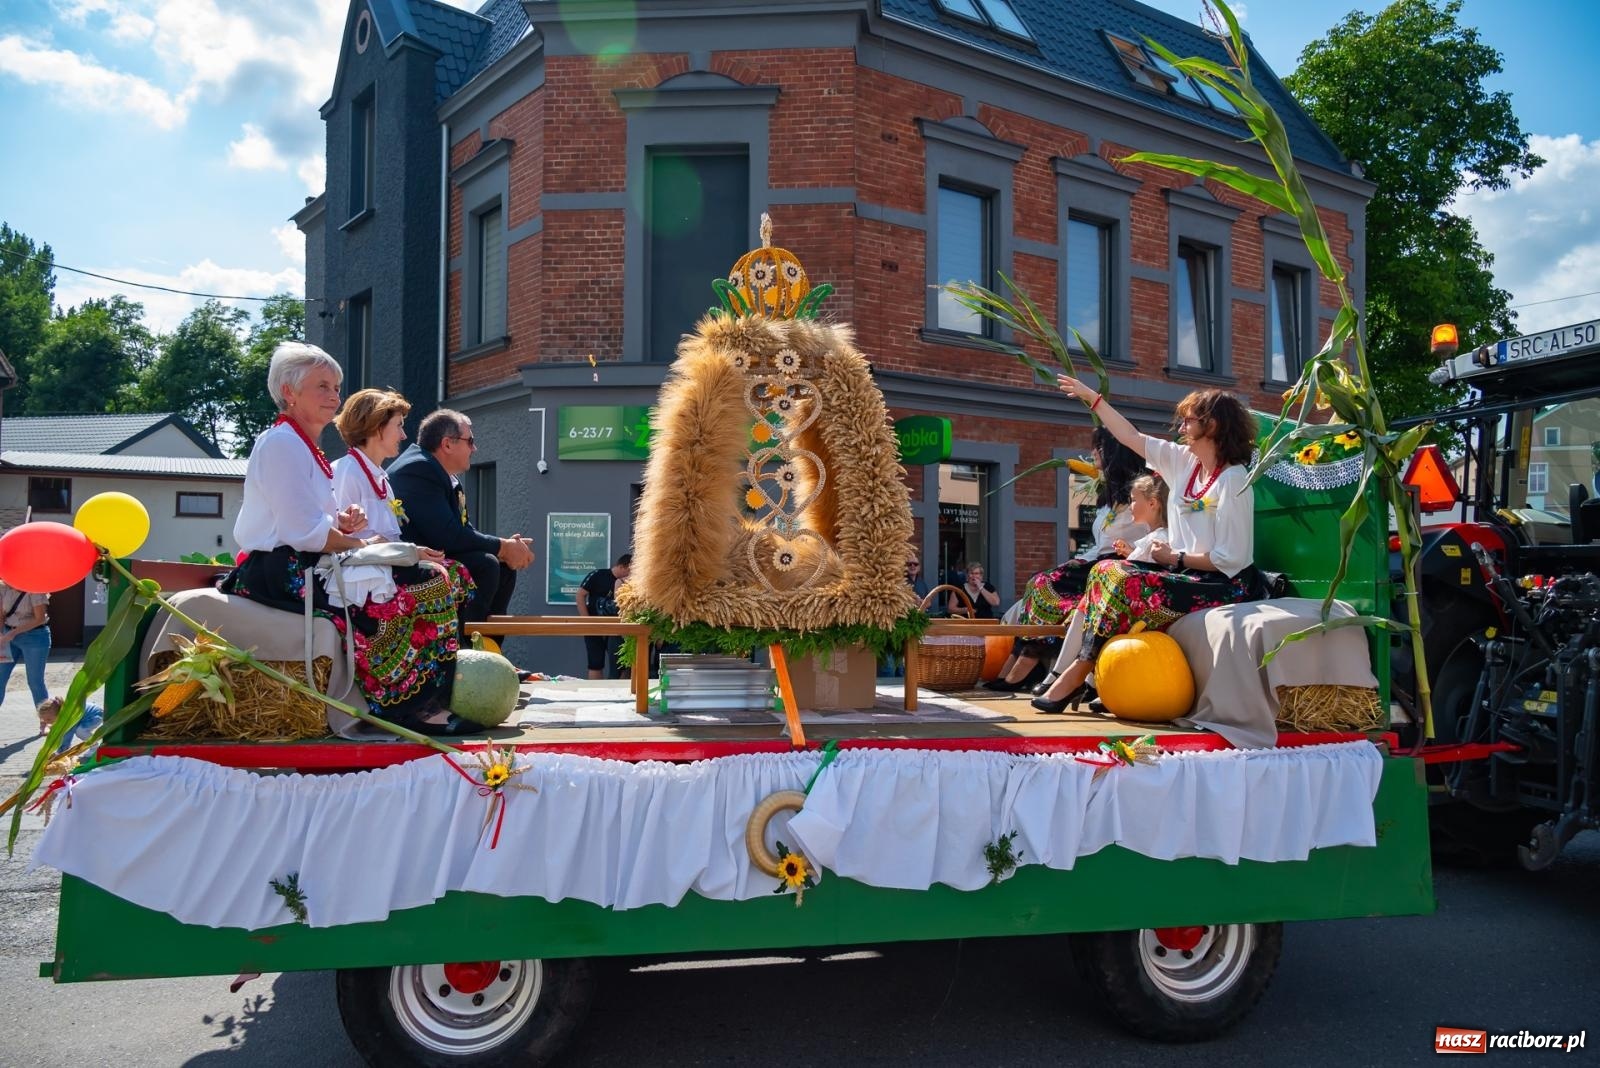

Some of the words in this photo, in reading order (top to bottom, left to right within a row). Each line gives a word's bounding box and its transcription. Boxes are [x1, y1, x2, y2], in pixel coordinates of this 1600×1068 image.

[1510, 336, 1543, 359] SRC
[1549, 324, 1596, 352] AL50
[569, 426, 613, 439] 6-23/7
[900, 427, 938, 447] abka
[553, 520, 594, 530] Poprowadź
